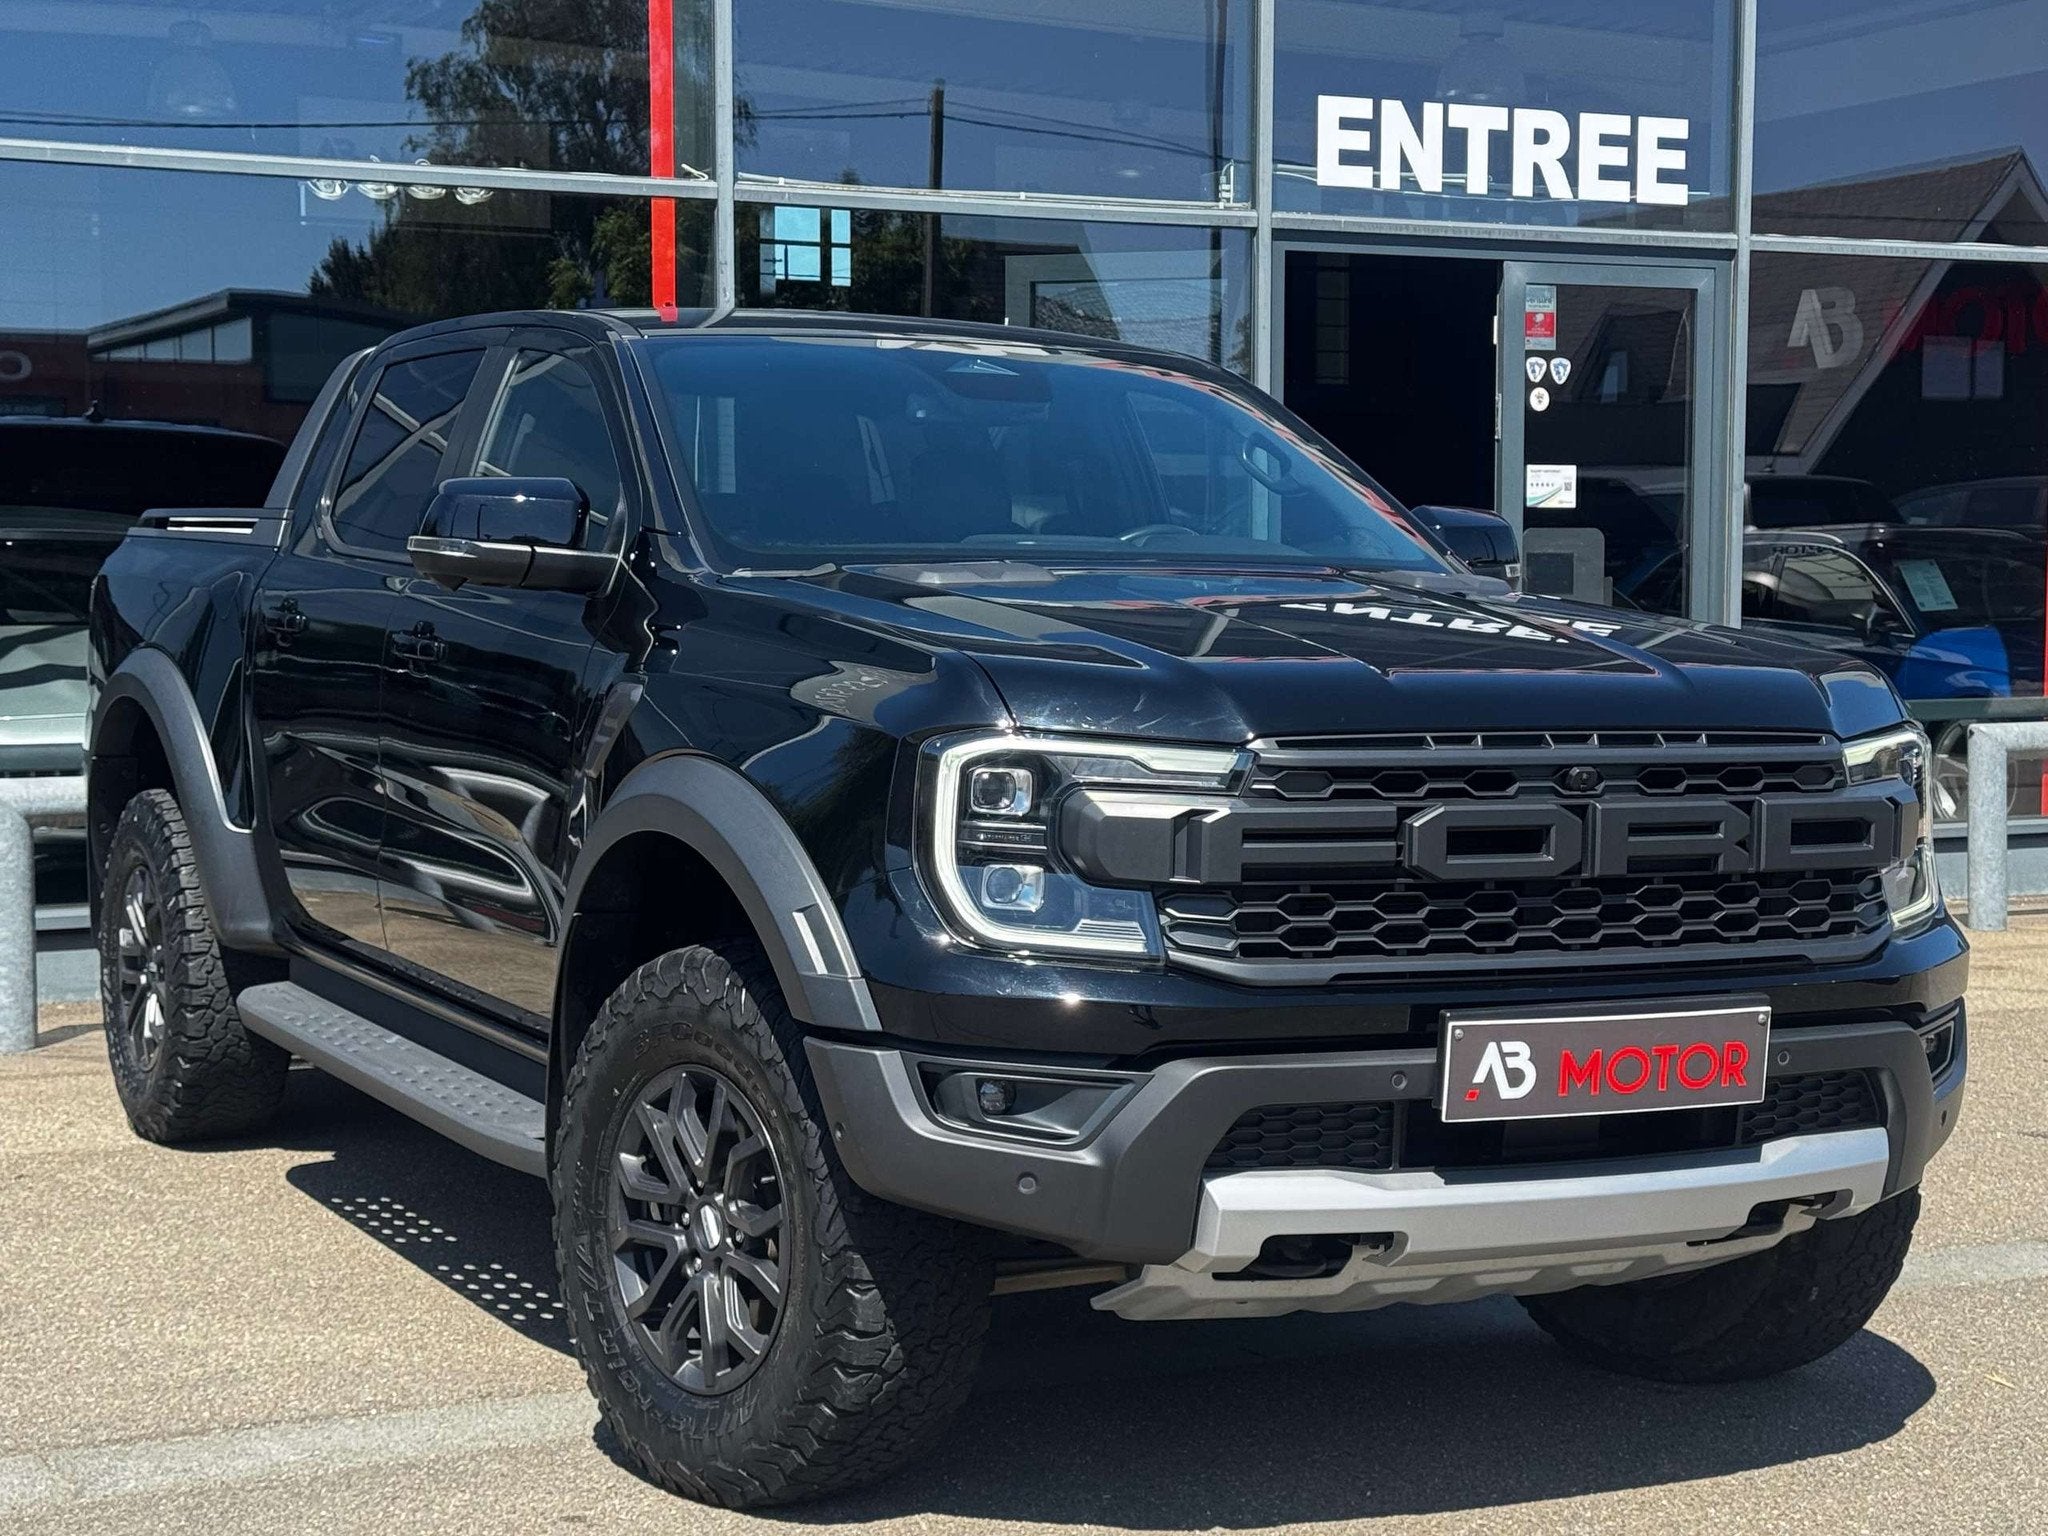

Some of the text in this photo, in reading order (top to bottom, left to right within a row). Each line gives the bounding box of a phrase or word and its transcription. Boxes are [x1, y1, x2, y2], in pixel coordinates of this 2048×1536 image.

[1316, 94, 1689, 206] ENTREE
[1188, 795, 1895, 884] FORD
[1472, 1041, 1749, 1099] AB MOTOR
